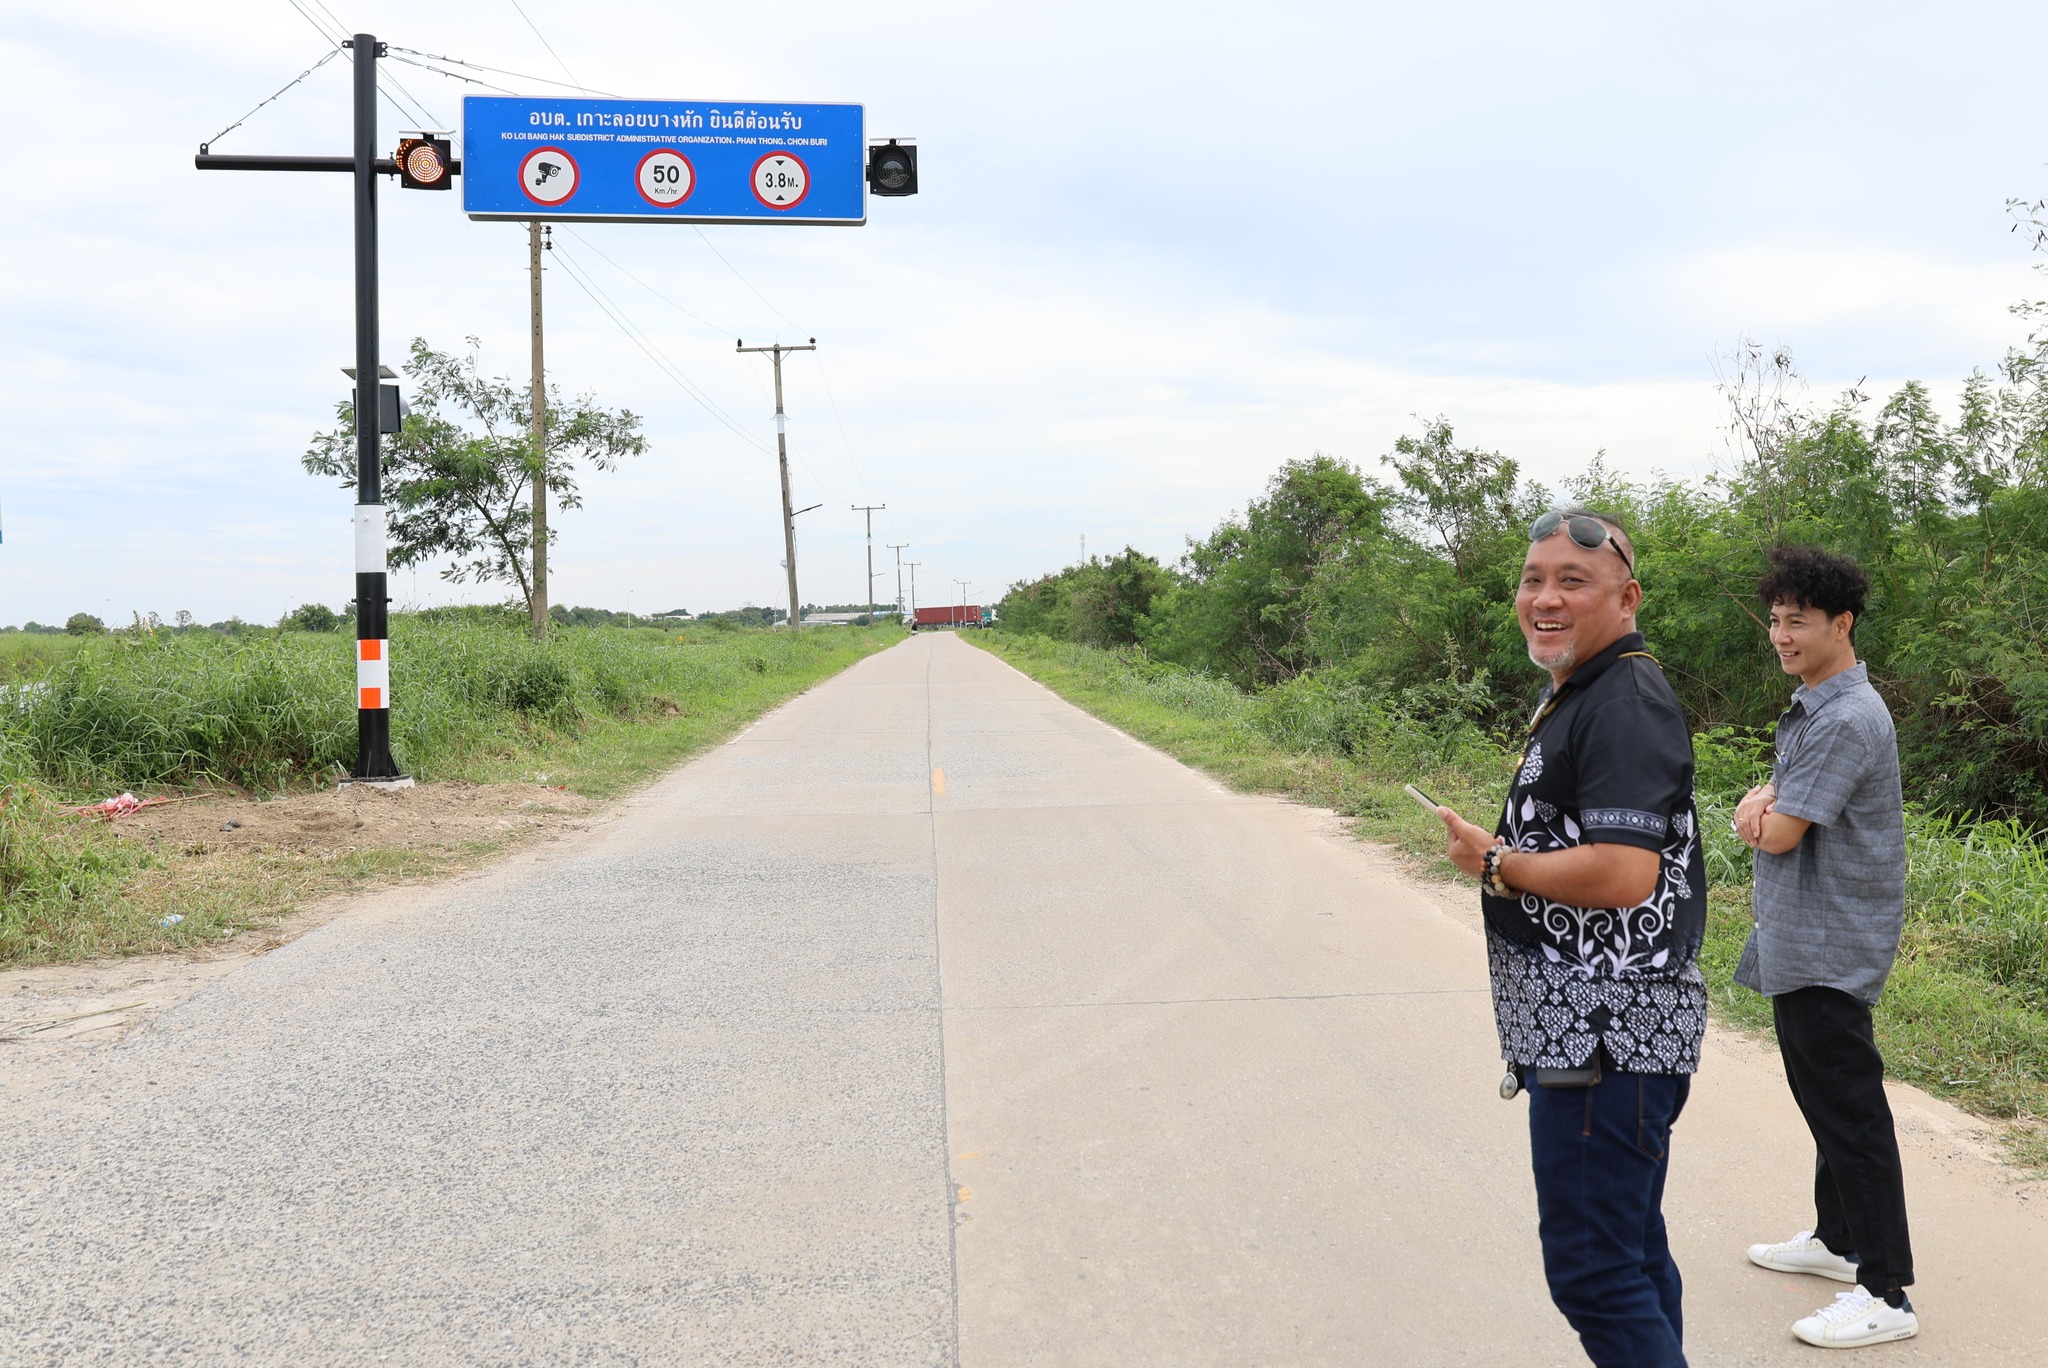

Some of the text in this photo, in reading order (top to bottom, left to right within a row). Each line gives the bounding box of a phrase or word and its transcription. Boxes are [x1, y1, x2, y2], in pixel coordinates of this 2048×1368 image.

[529, 108, 802, 130] อบต. เกาะลอยบางหัก ยินดีต้อนรับ
[501, 132, 513, 140] KO
[514, 132, 526, 140] LOI
[527, 132, 548, 141] BANG
[550, 133, 565, 142] HAK
[567, 133, 614, 142] SUBDISTRICT
[616, 135, 677, 144] ADMINISTRATIVE
[736, 137, 757, 145] PHAN
[787, 138, 809, 146] CHON
[810, 138, 828, 146] BURI
[653, 165, 680, 184] 50
